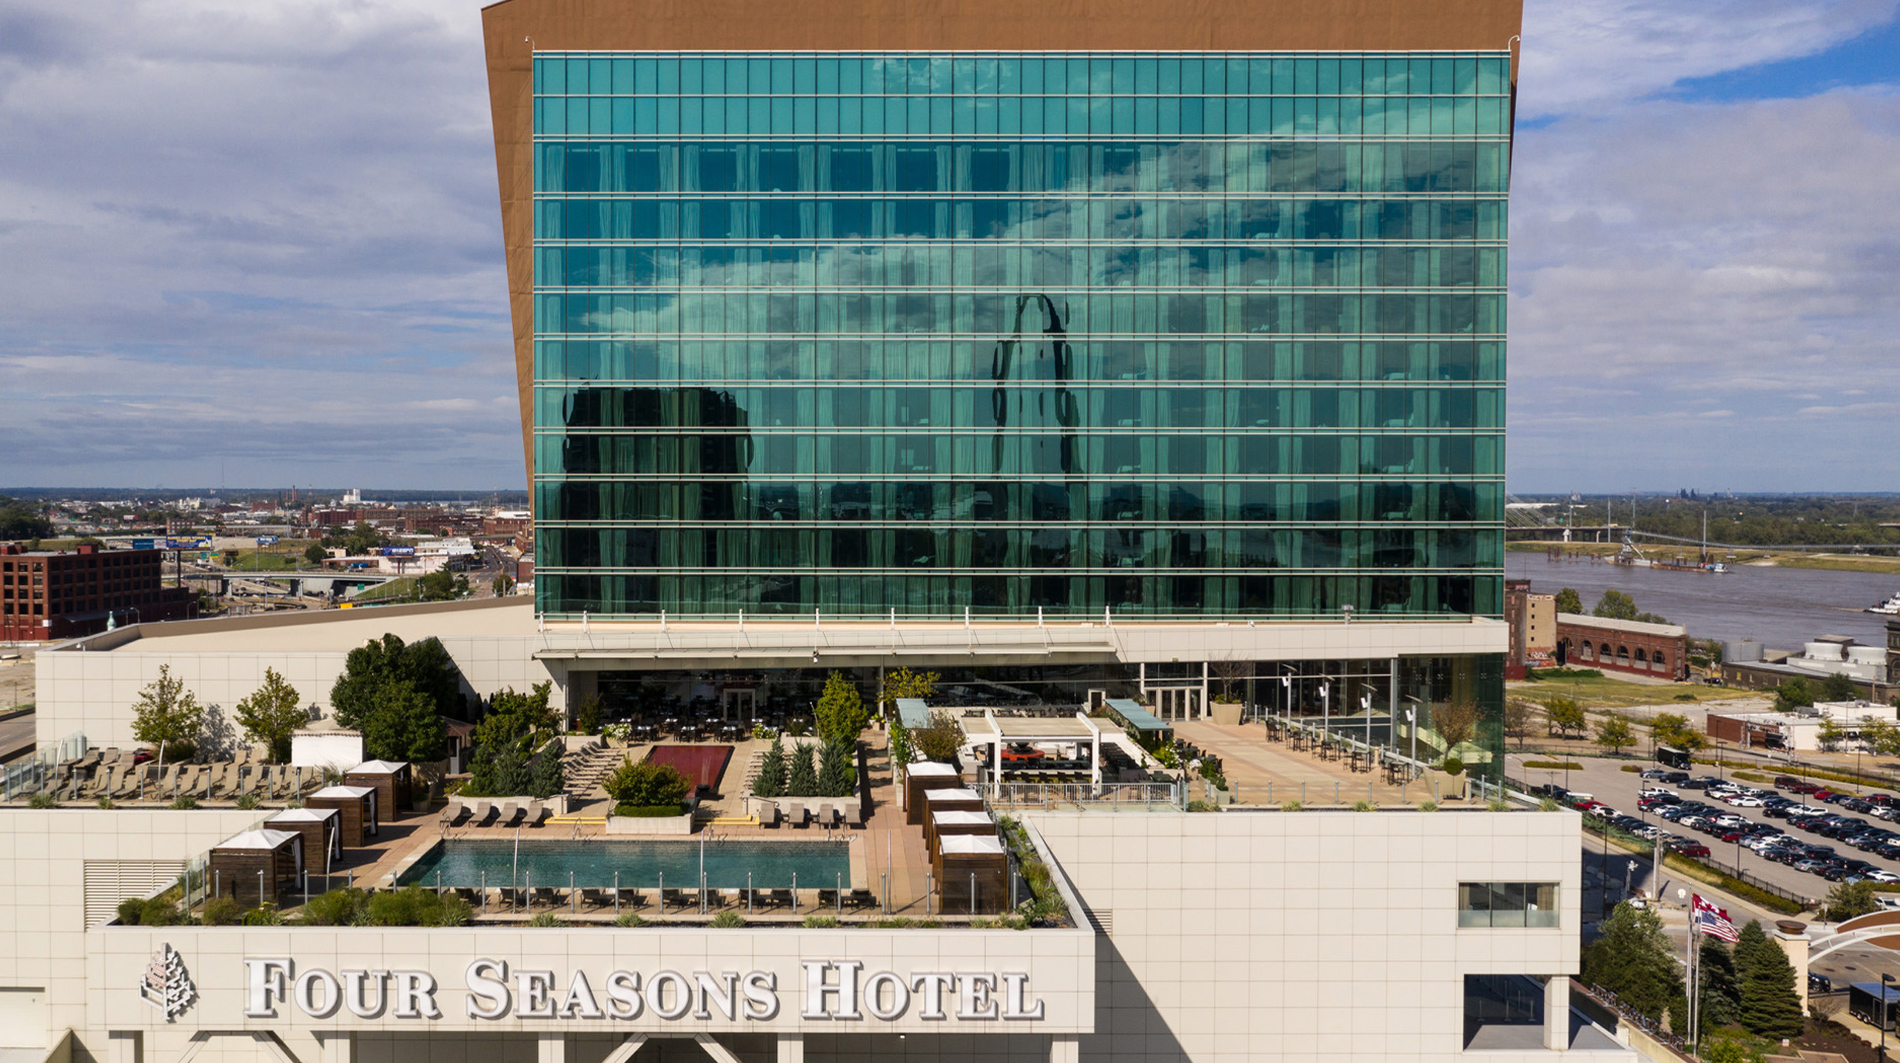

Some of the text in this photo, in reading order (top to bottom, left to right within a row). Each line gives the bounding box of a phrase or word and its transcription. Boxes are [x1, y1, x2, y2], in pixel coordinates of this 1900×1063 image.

[243, 956, 1044, 1021] FOUR SEASONS HOTEL
